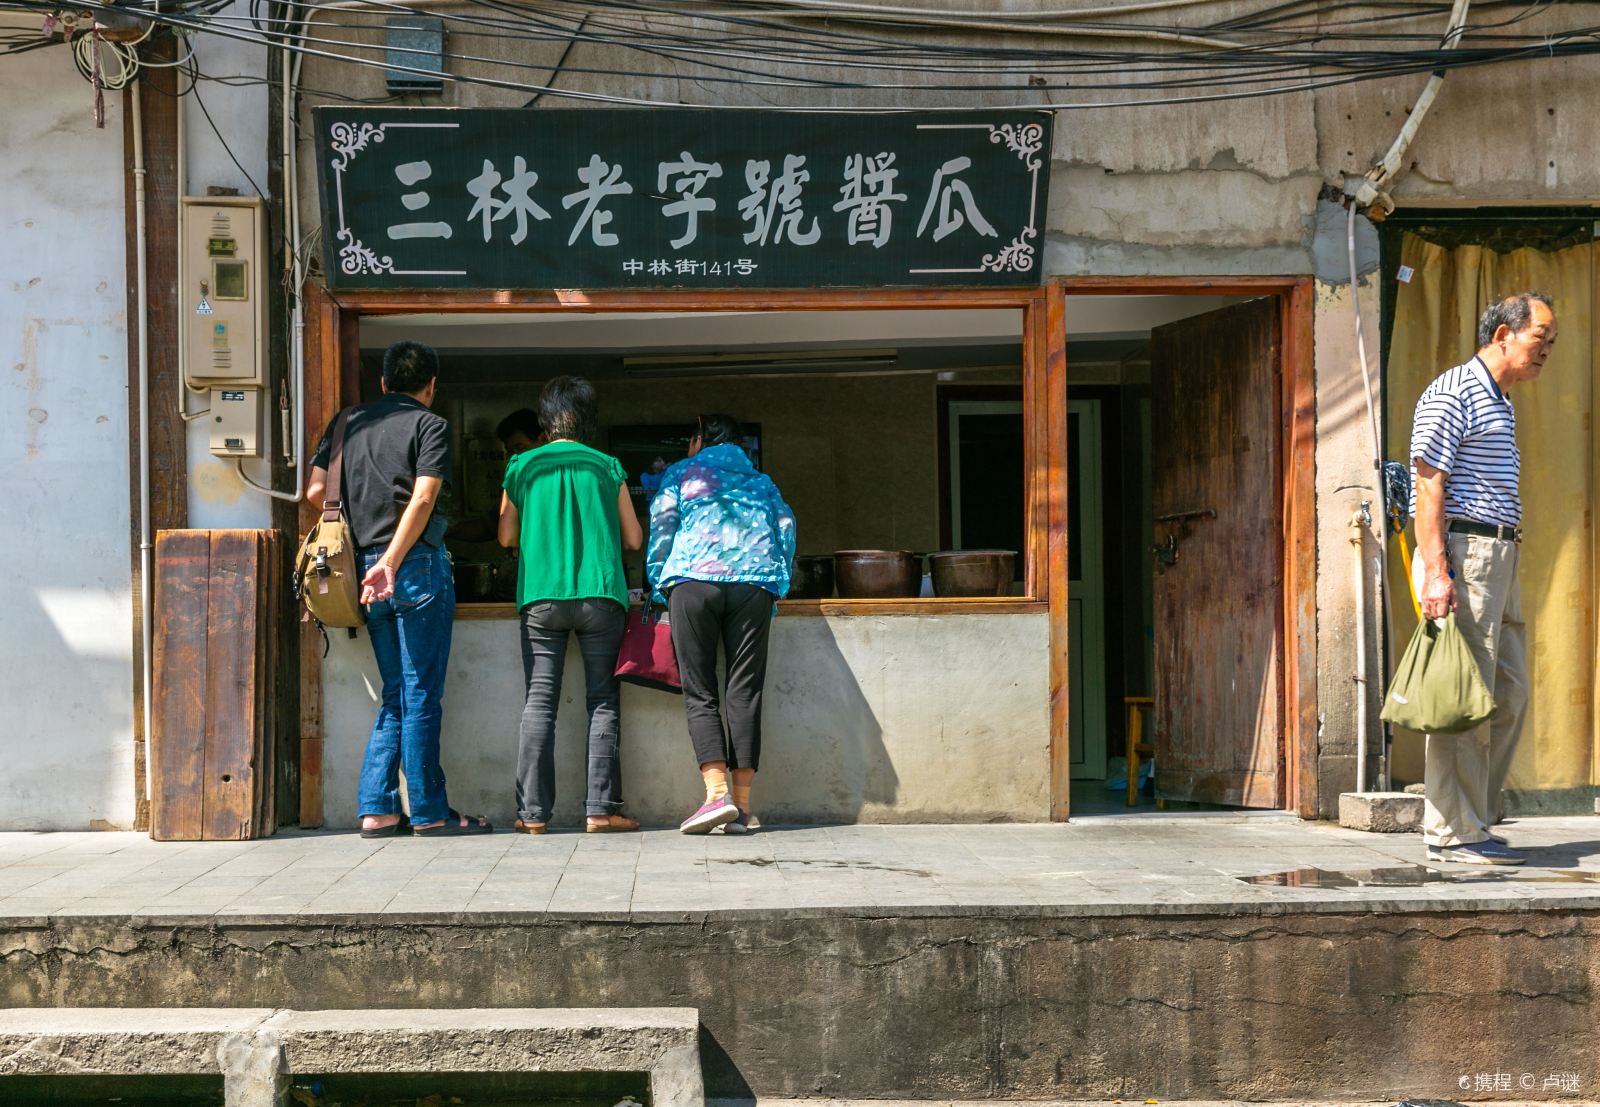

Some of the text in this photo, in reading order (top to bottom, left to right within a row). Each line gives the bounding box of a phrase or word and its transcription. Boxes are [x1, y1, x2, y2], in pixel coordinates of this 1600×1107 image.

[387, 151, 999, 250] 三林老字號醬瓜
[622, 258, 759, 276] 中林街141号
